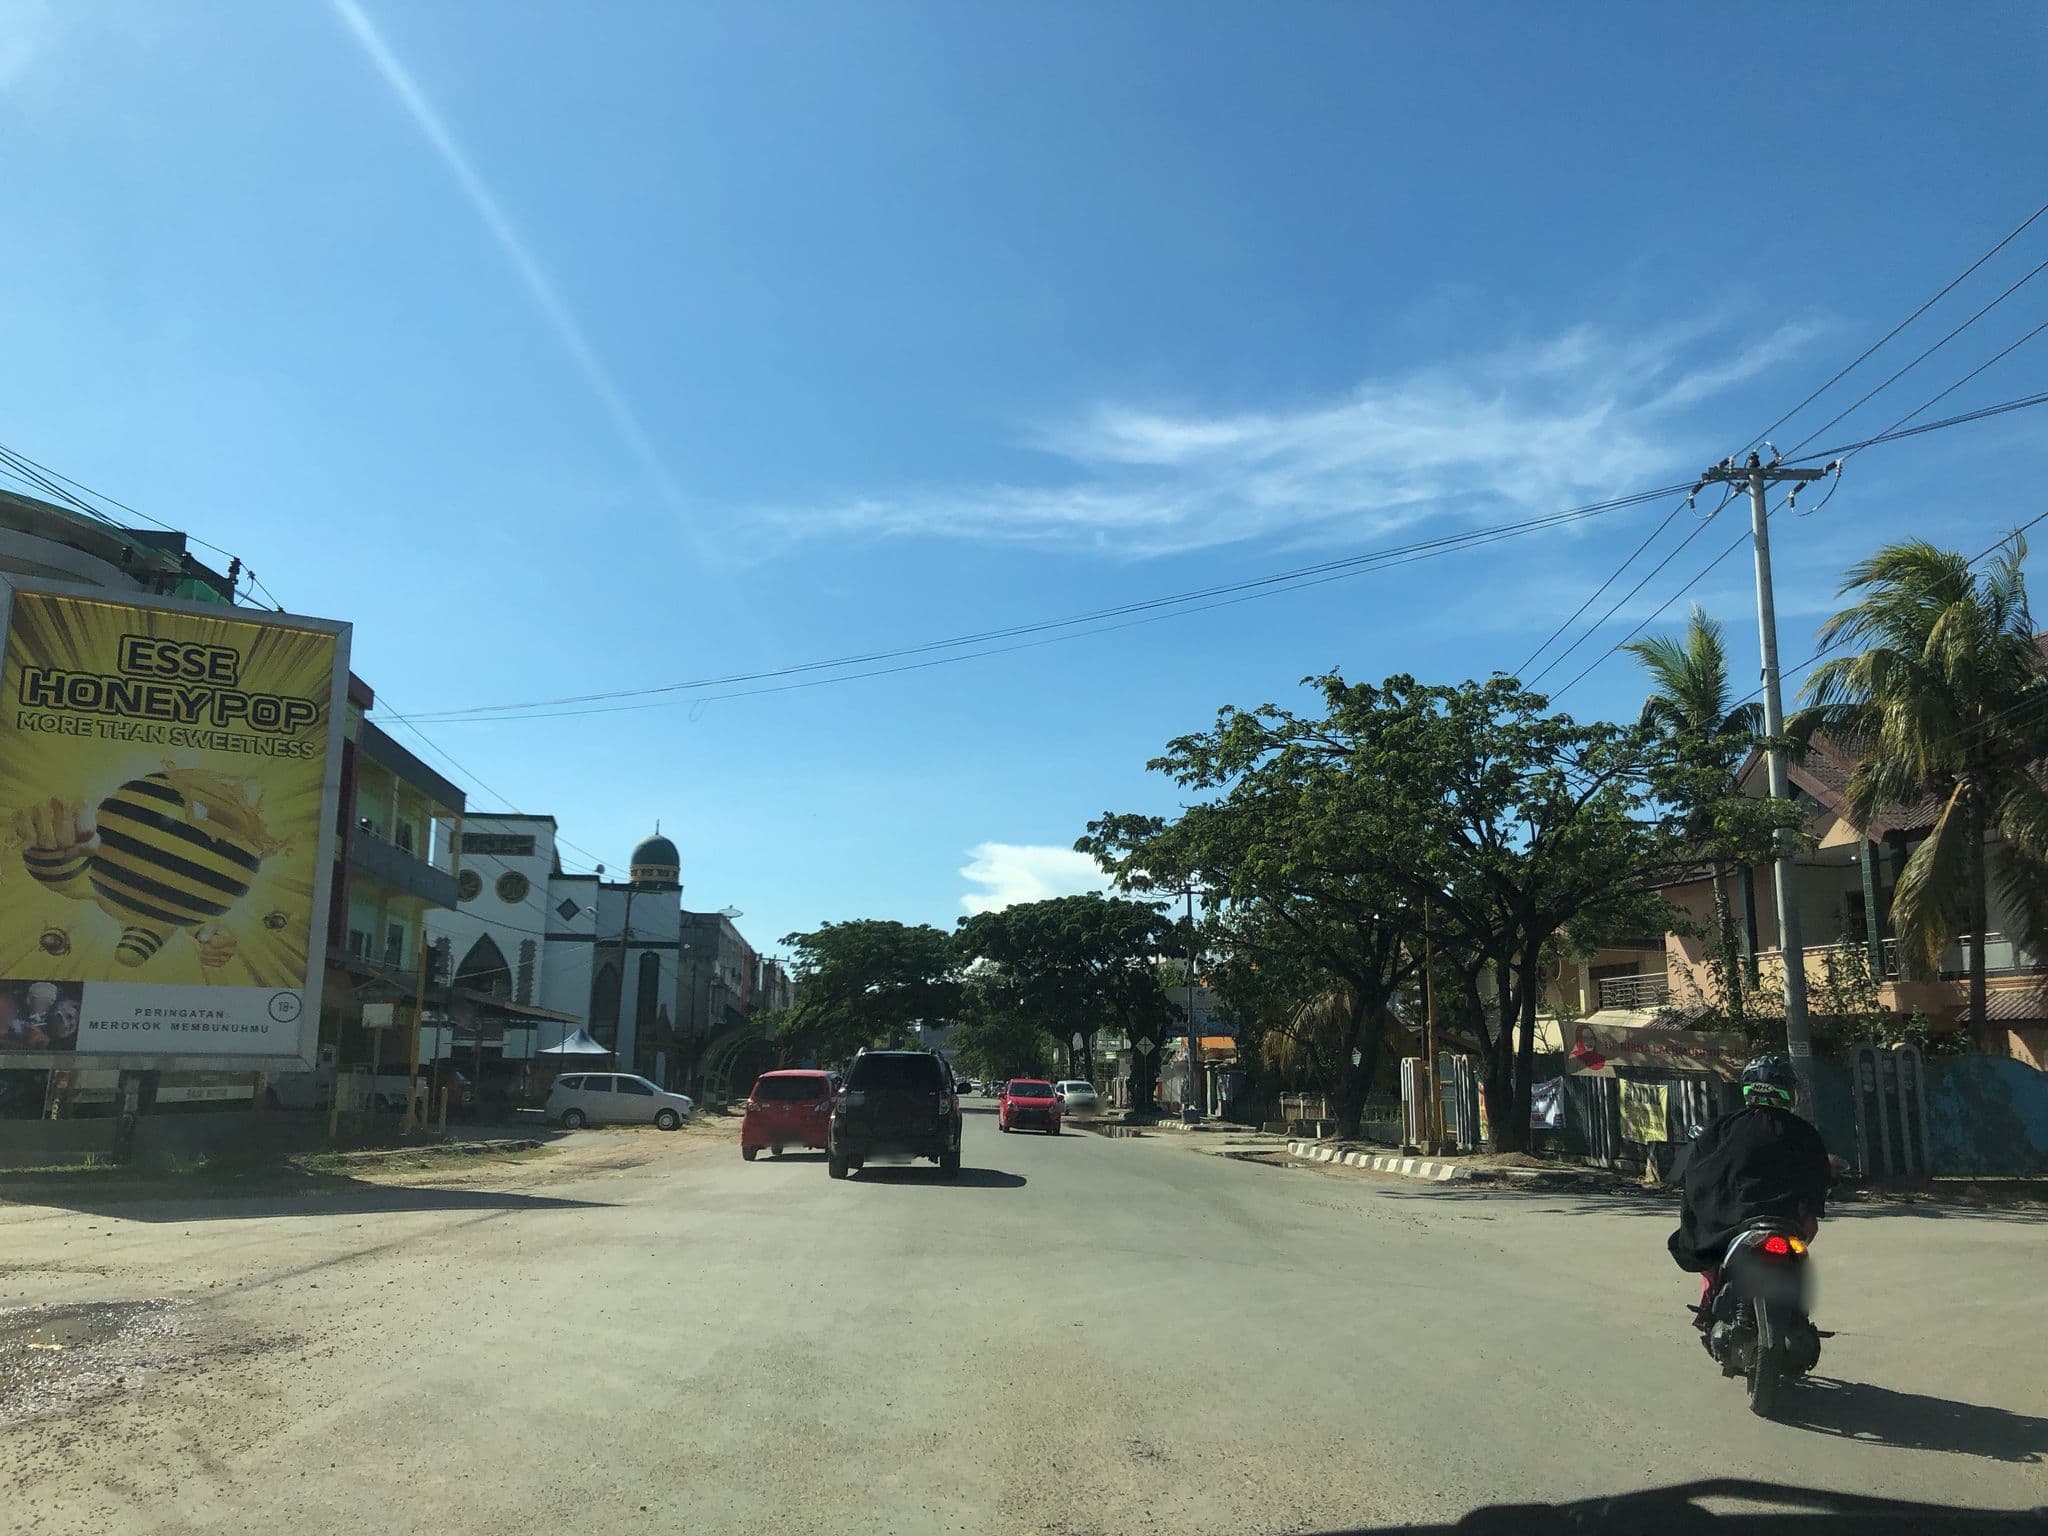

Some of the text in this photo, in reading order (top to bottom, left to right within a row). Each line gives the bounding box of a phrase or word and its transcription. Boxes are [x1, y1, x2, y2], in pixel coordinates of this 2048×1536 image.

[121, 636, 238, 685] ESSE
[17, 712, 315, 760] MORE THAN SWEETNESS
[88, 1020, 270, 1034] MEROKOK MEMBUNUHMU
[134, 1008, 225, 1020] PERINGATAN
